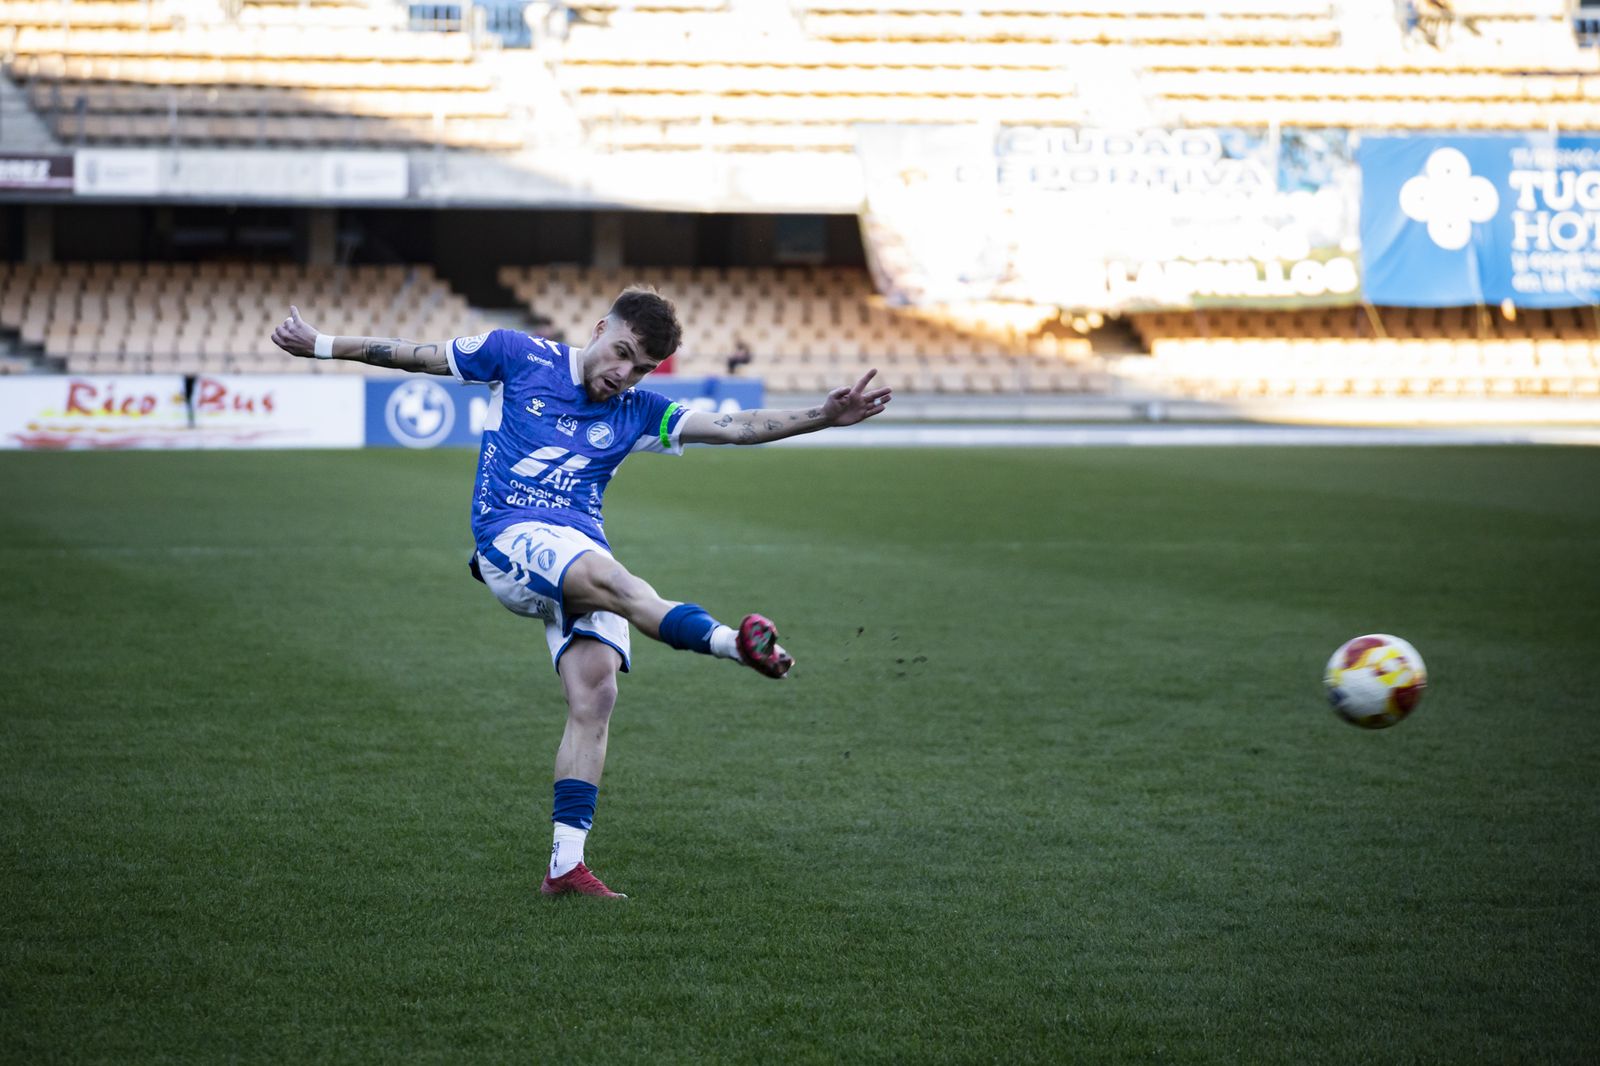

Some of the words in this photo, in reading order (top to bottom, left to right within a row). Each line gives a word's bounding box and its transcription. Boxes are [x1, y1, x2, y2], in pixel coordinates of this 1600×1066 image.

[65, 378, 157, 416] Rico
[197, 377, 275, 412] Bus
[509, 479, 572, 507] oneaires
[539, 467, 582, 492] Air
